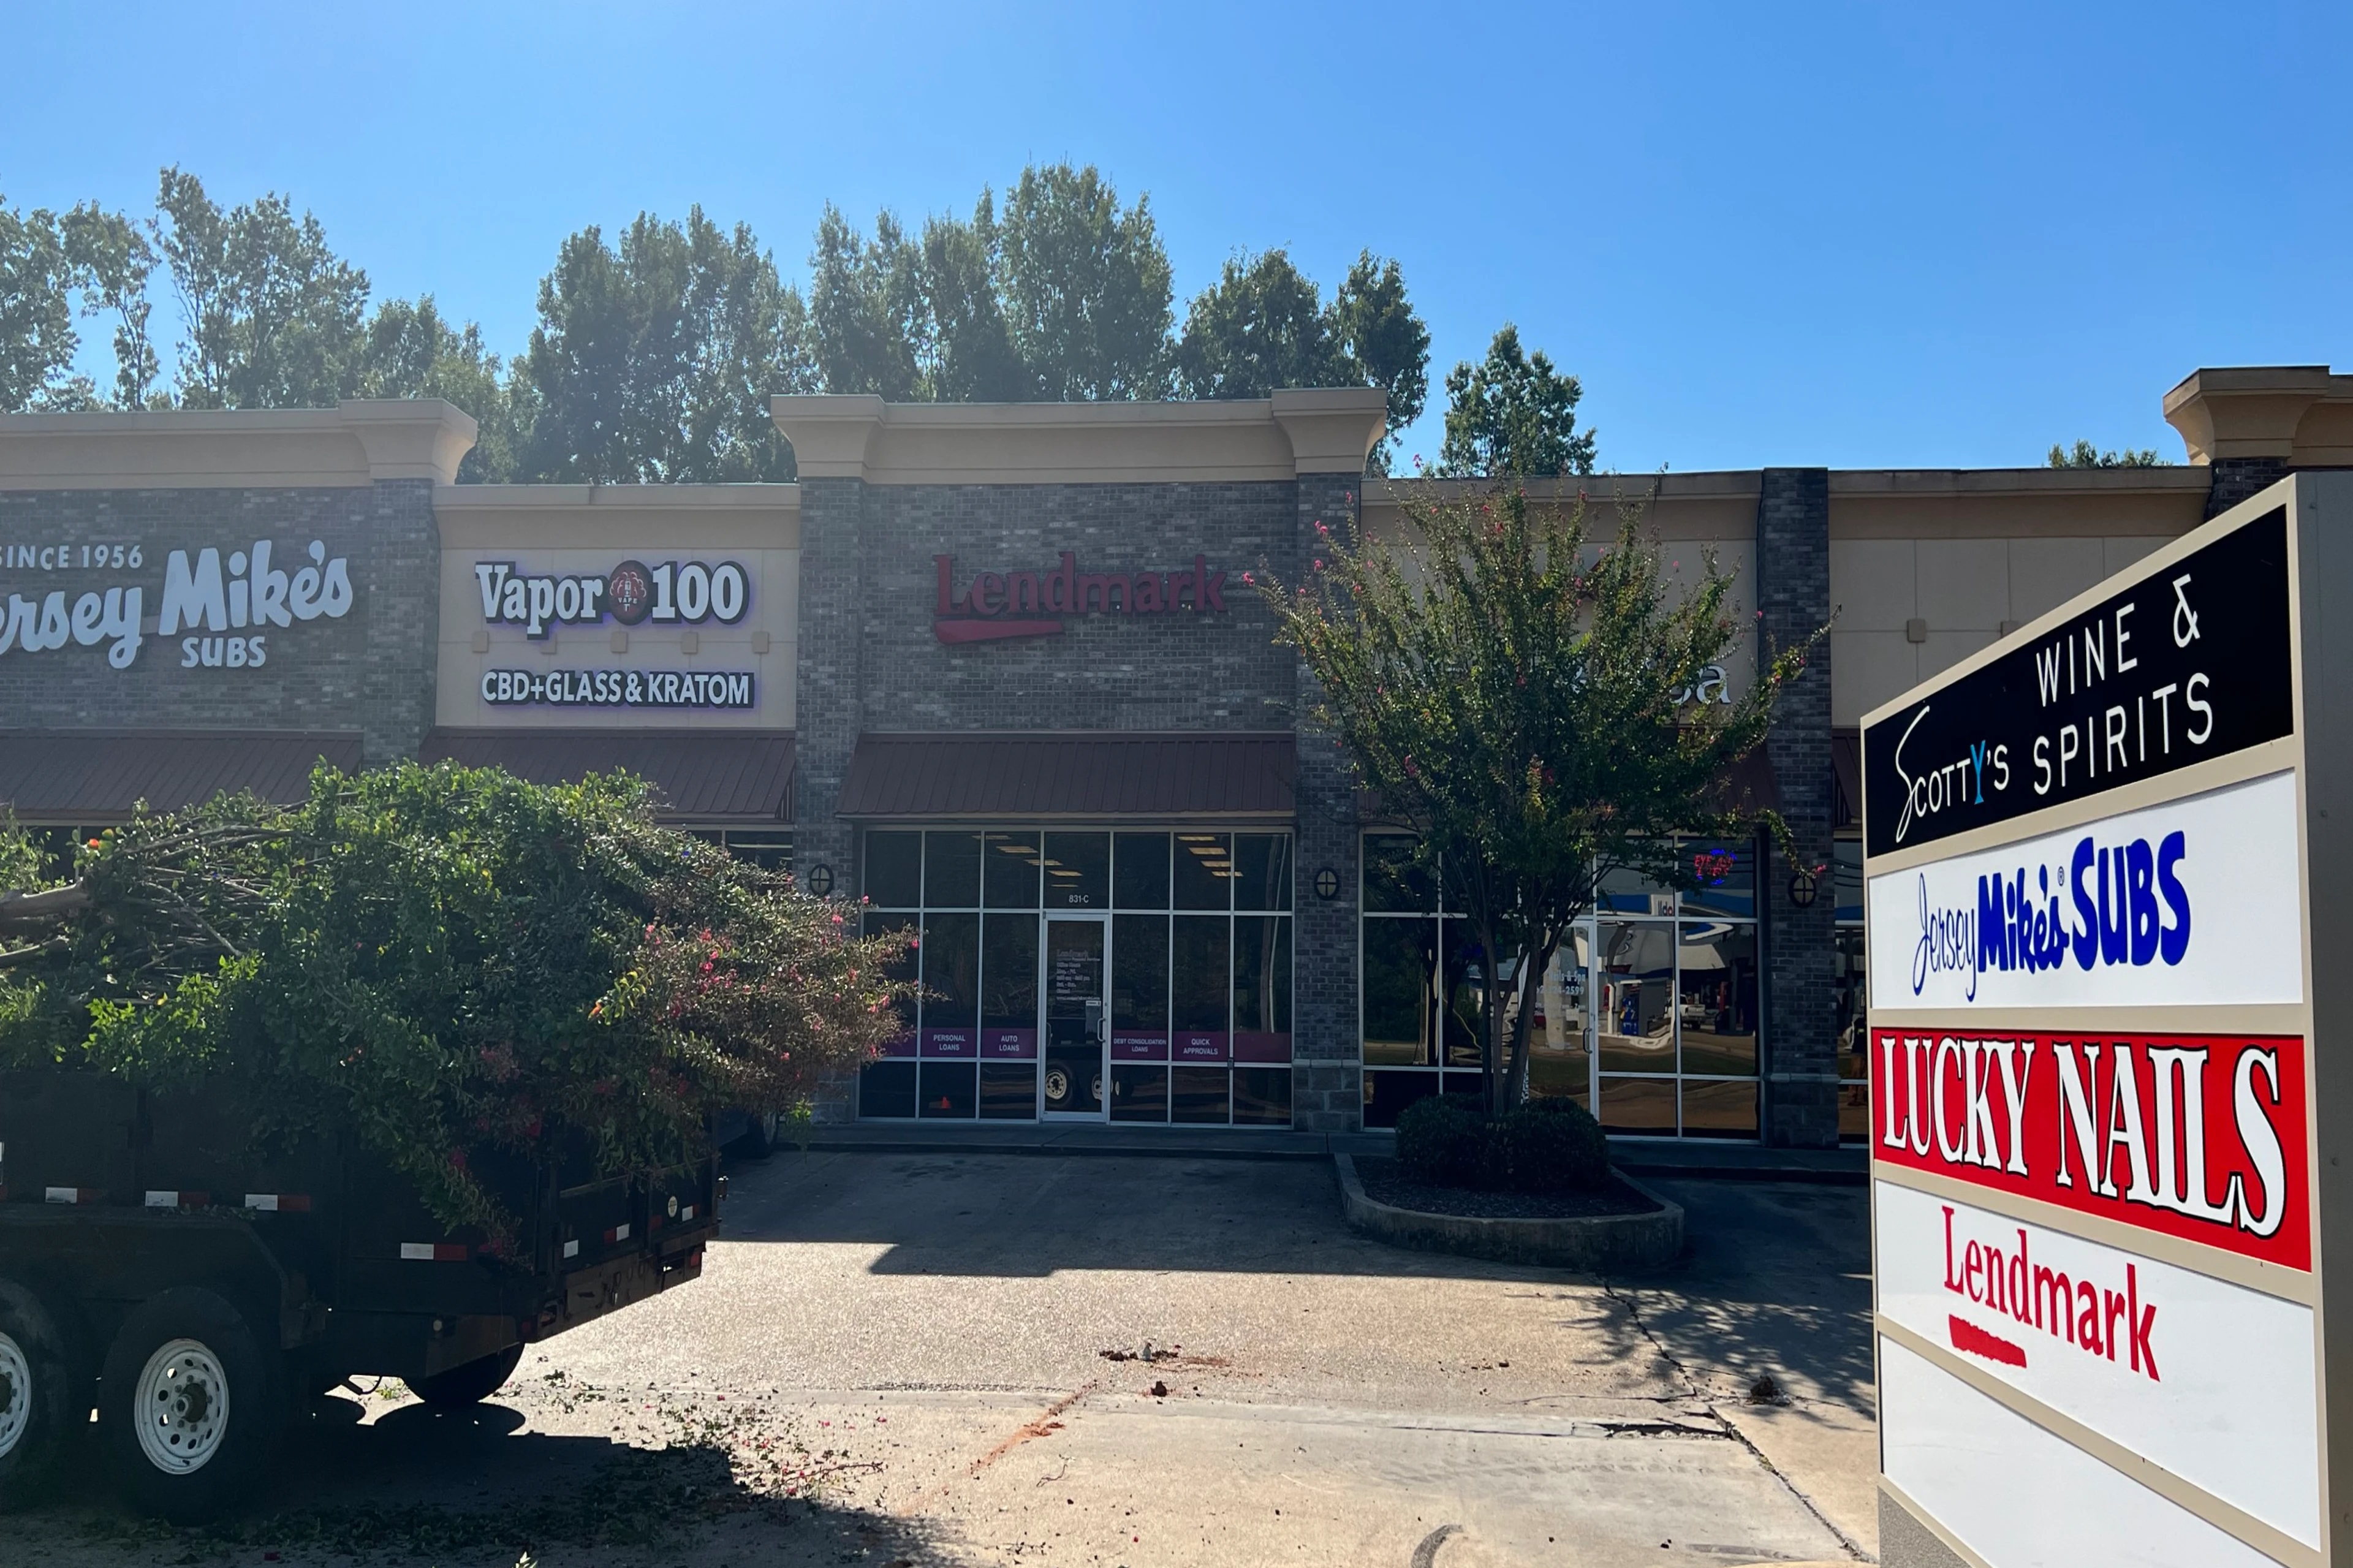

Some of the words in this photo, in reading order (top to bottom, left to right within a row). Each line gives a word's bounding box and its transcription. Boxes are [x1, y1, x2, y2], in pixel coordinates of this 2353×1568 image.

[0, 545, 69, 570] INCE
[81, 545, 143, 569] 1956
[157, 539, 354, 636] Mike's
[475, 562, 604, 636] Vapor
[652, 562, 746, 621] 100
[932, 551, 1228, 616] Lendmark
[180, 635, 267, 668] SUBS
[2035, 602, 2139, 708] WINE
[2172, 574, 2201, 648] &
[647, 672, 750, 705] KRATOM
[2033, 672, 2214, 795] SPIRITS
[1068, 894, 1089, 903] 831-C
[1912, 873, 1978, 1002] Jersey
[2070, 830, 2191, 972] SUBS
[1880, 1035, 2036, 1180] LUCKY
[2053, 1042, 2287, 1240] NAILS
[1941, 1205, 2161, 1383] Lendmark
